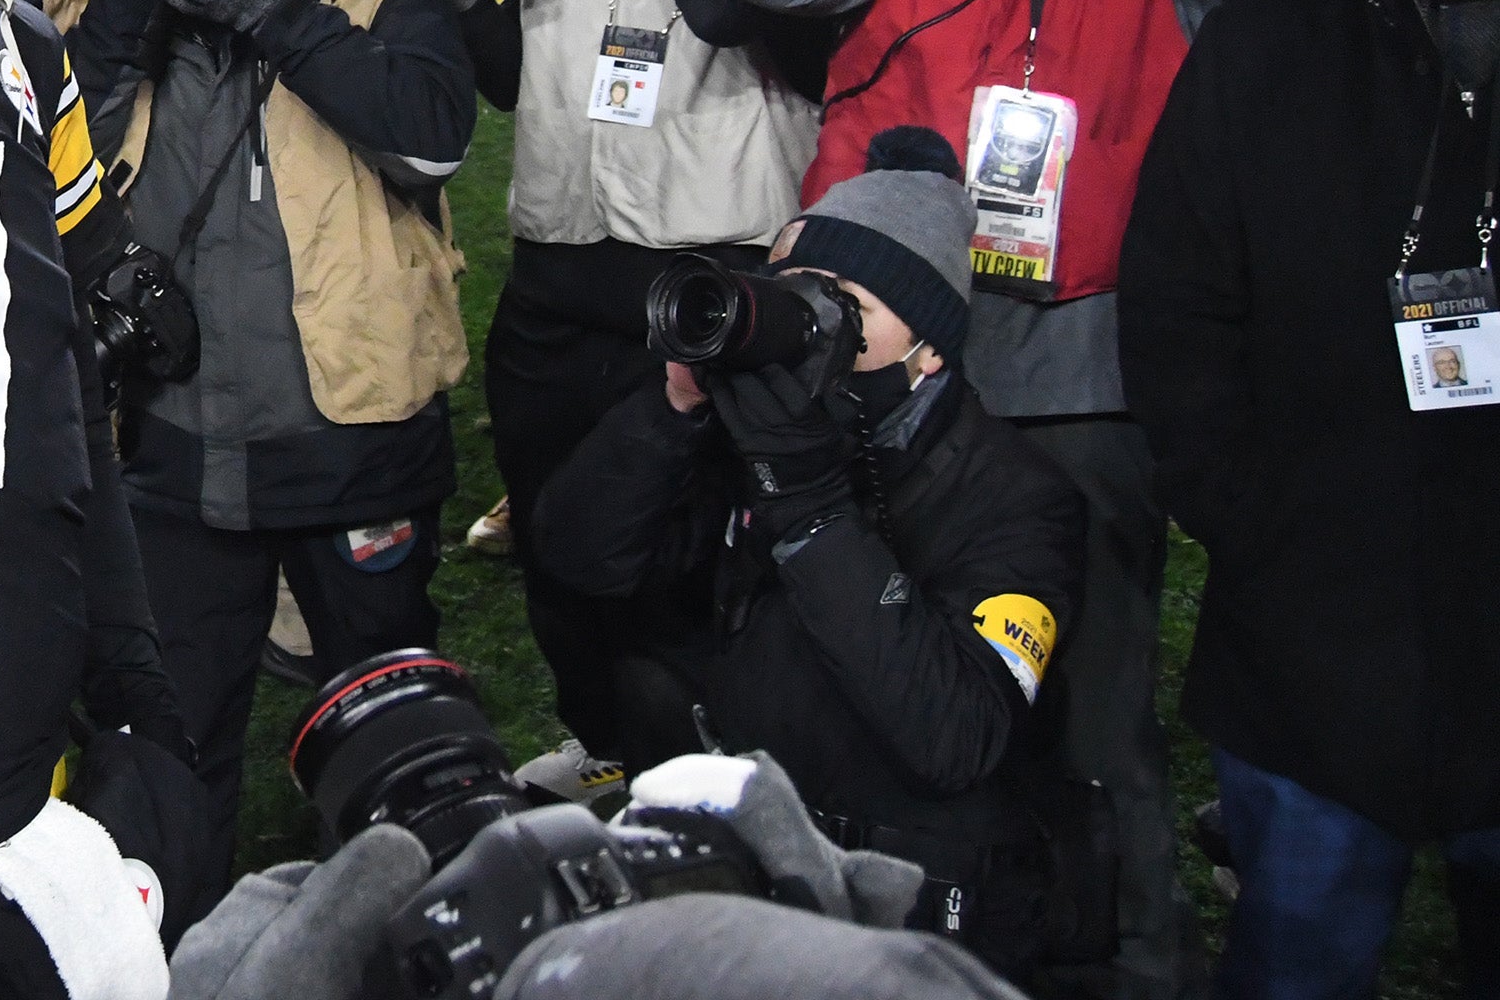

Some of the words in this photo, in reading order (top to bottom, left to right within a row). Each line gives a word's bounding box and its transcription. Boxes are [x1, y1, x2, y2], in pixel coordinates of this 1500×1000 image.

[974, 250, 992, 273] TV
[994, 255, 1037, 279] CREW
[1402, 303, 1434, 319] 2021
[1434, 296, 1489, 316] OFFICIAL
